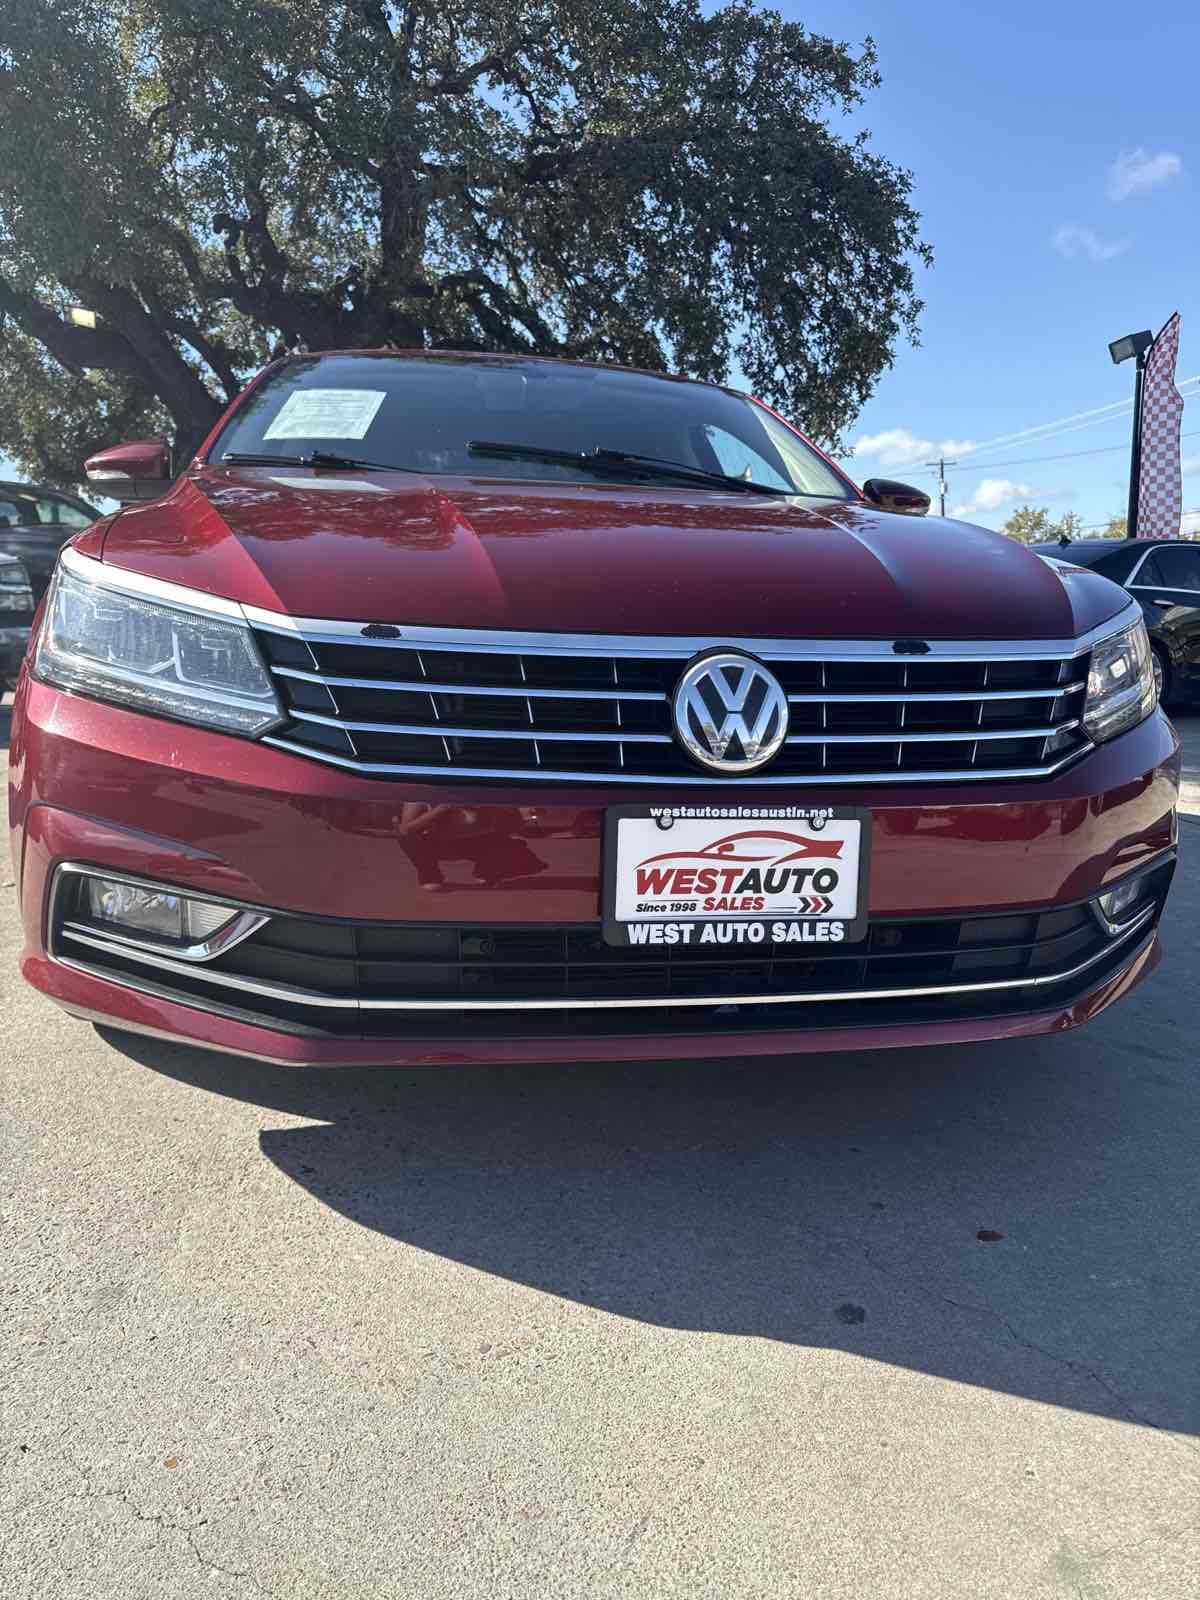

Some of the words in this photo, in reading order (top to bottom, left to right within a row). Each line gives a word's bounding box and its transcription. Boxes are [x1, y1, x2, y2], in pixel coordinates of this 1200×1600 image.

[650, 806, 834, 818] westautosalesaustin.net
[636, 902, 668, 913] Since
[670, 902, 697, 912] 1998
[702, 897, 765, 911] SALES
[628, 923, 695, 944] WEST
[700, 923, 765, 943] AUTO
[772, 922, 844, 942] SALES
